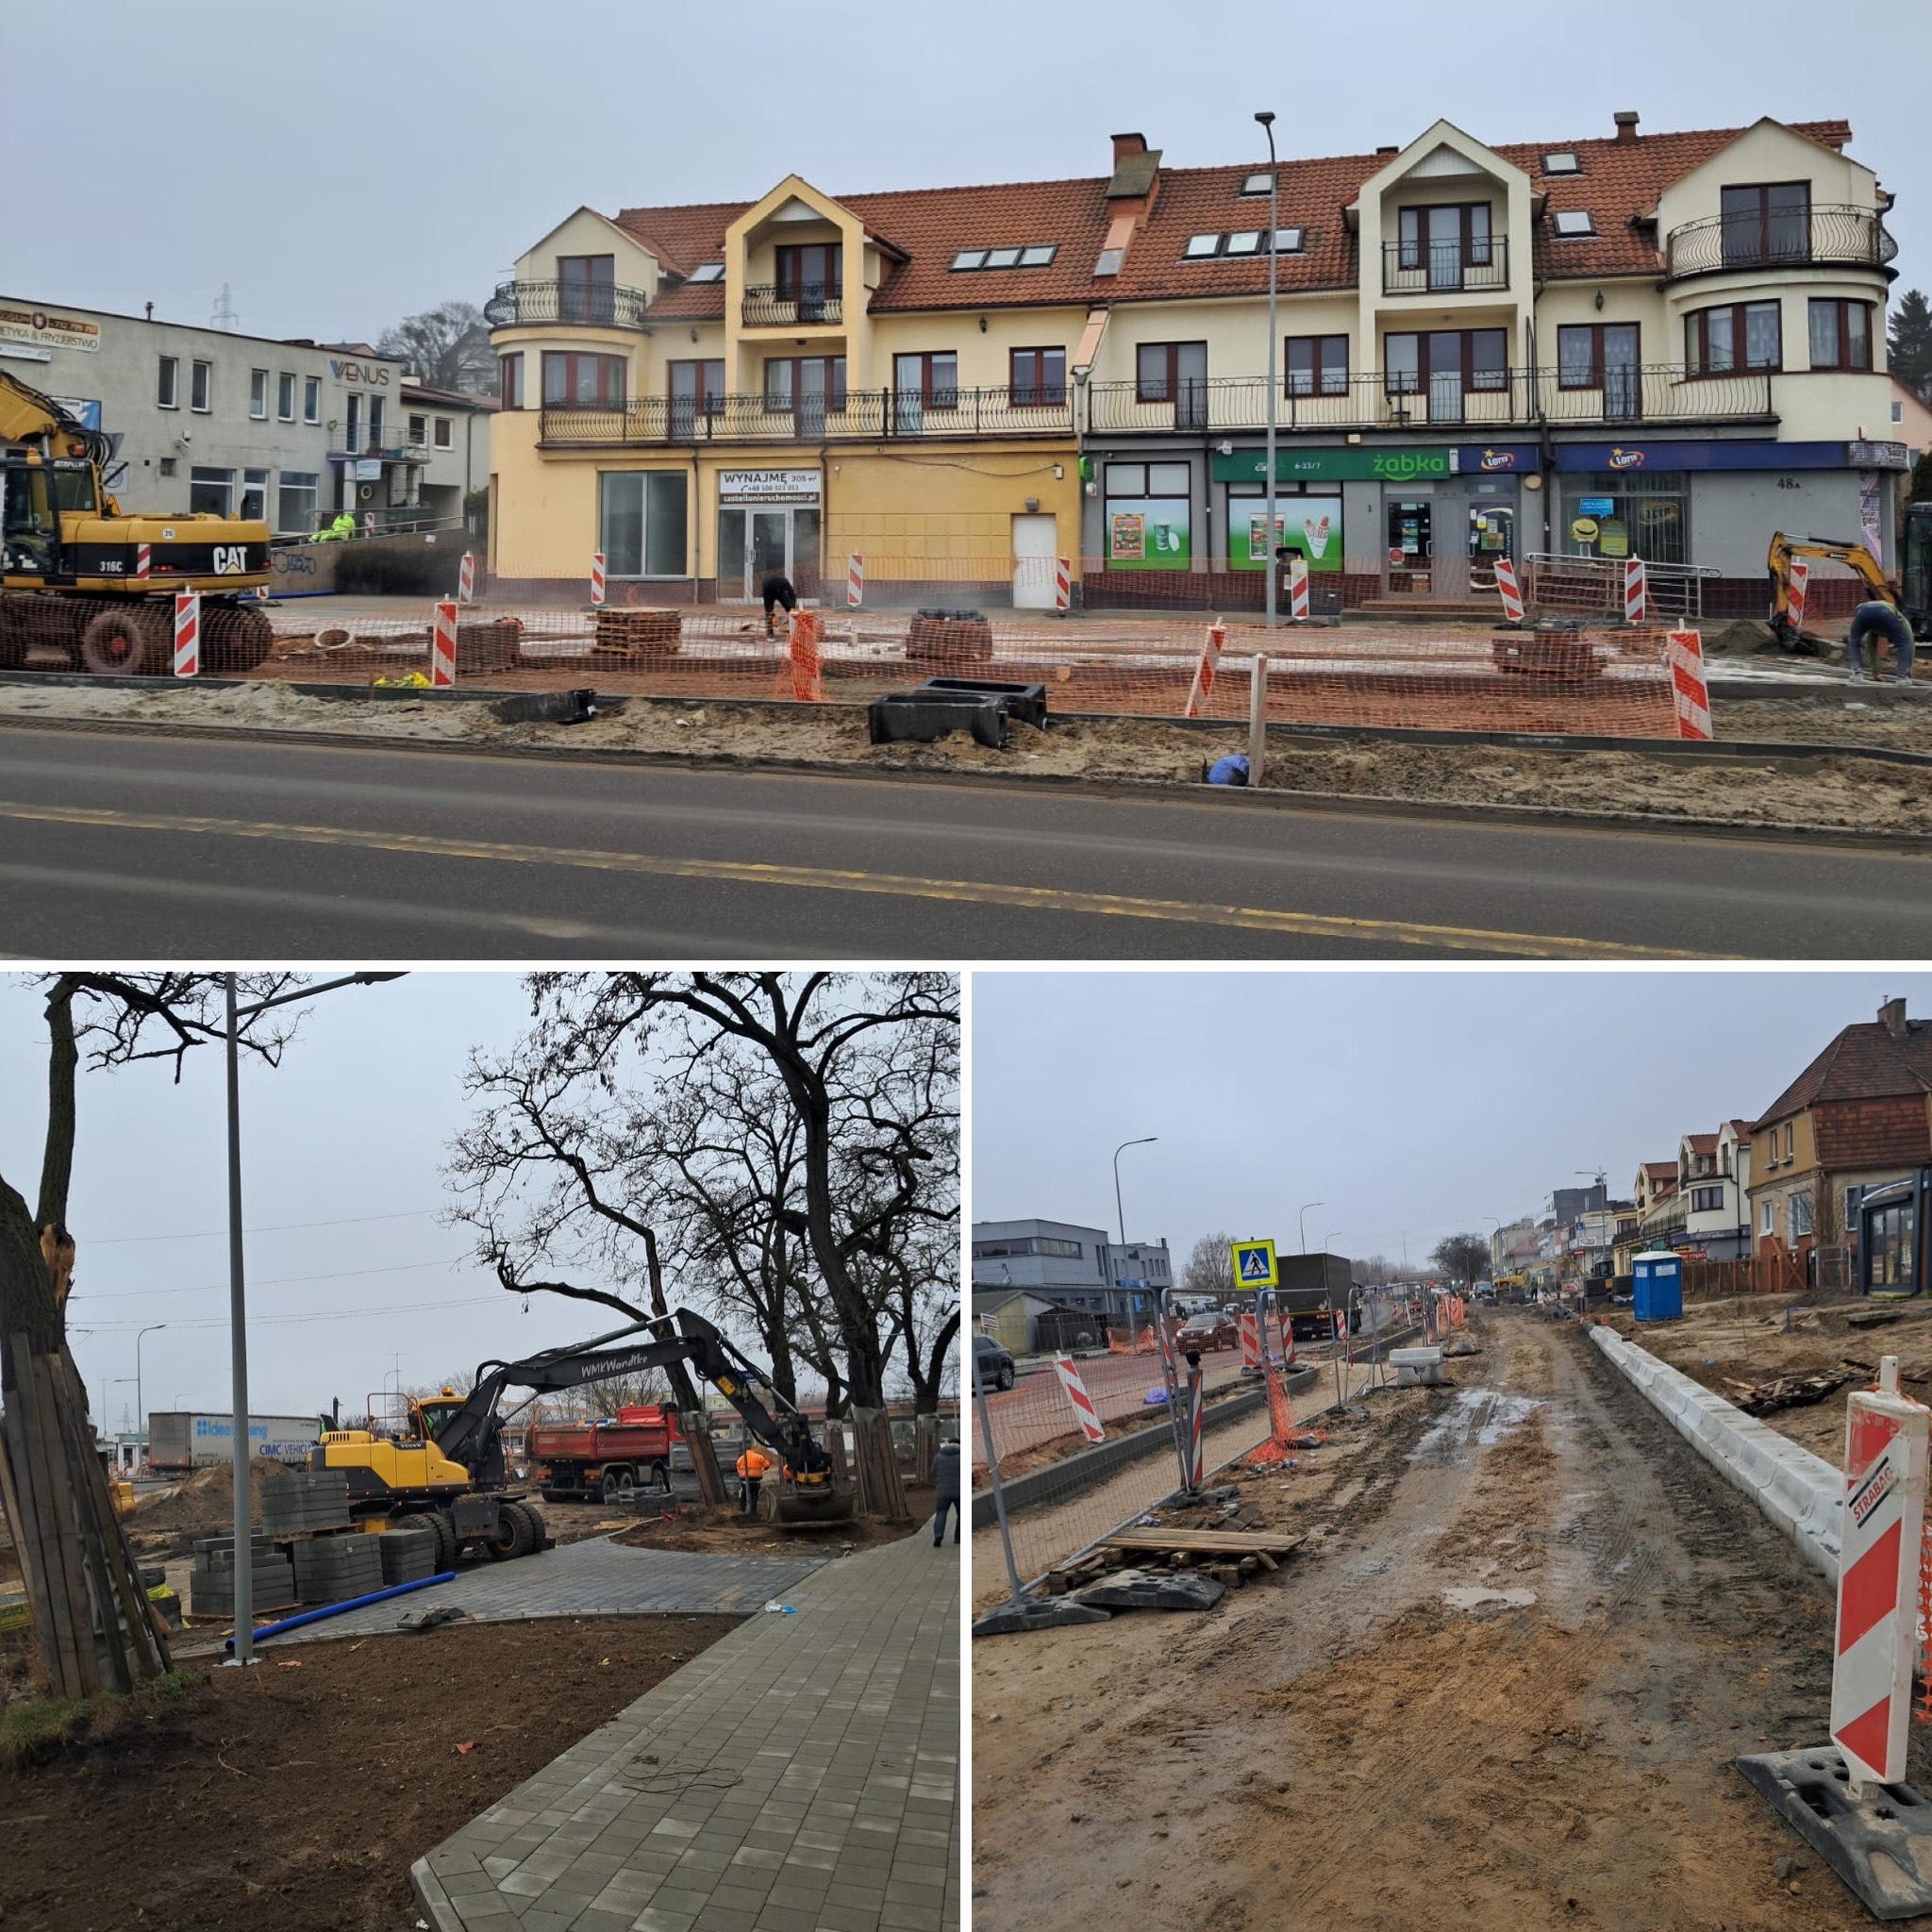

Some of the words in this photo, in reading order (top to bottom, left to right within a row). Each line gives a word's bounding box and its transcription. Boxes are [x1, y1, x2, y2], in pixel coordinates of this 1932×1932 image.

[42, 332, 98, 348] FRYZJERSTWO
[330, 358, 390, 385] VENUS
[1374, 454, 1444, 472] żabka
[724, 473, 787, 484] WYNAJMĘ
[99, 560, 124, 573] 316C
[213, 546, 247, 575] CAT
[259, 1444, 281, 1456] CIMC
[1852, 1466, 1895, 1521] STRABAG
